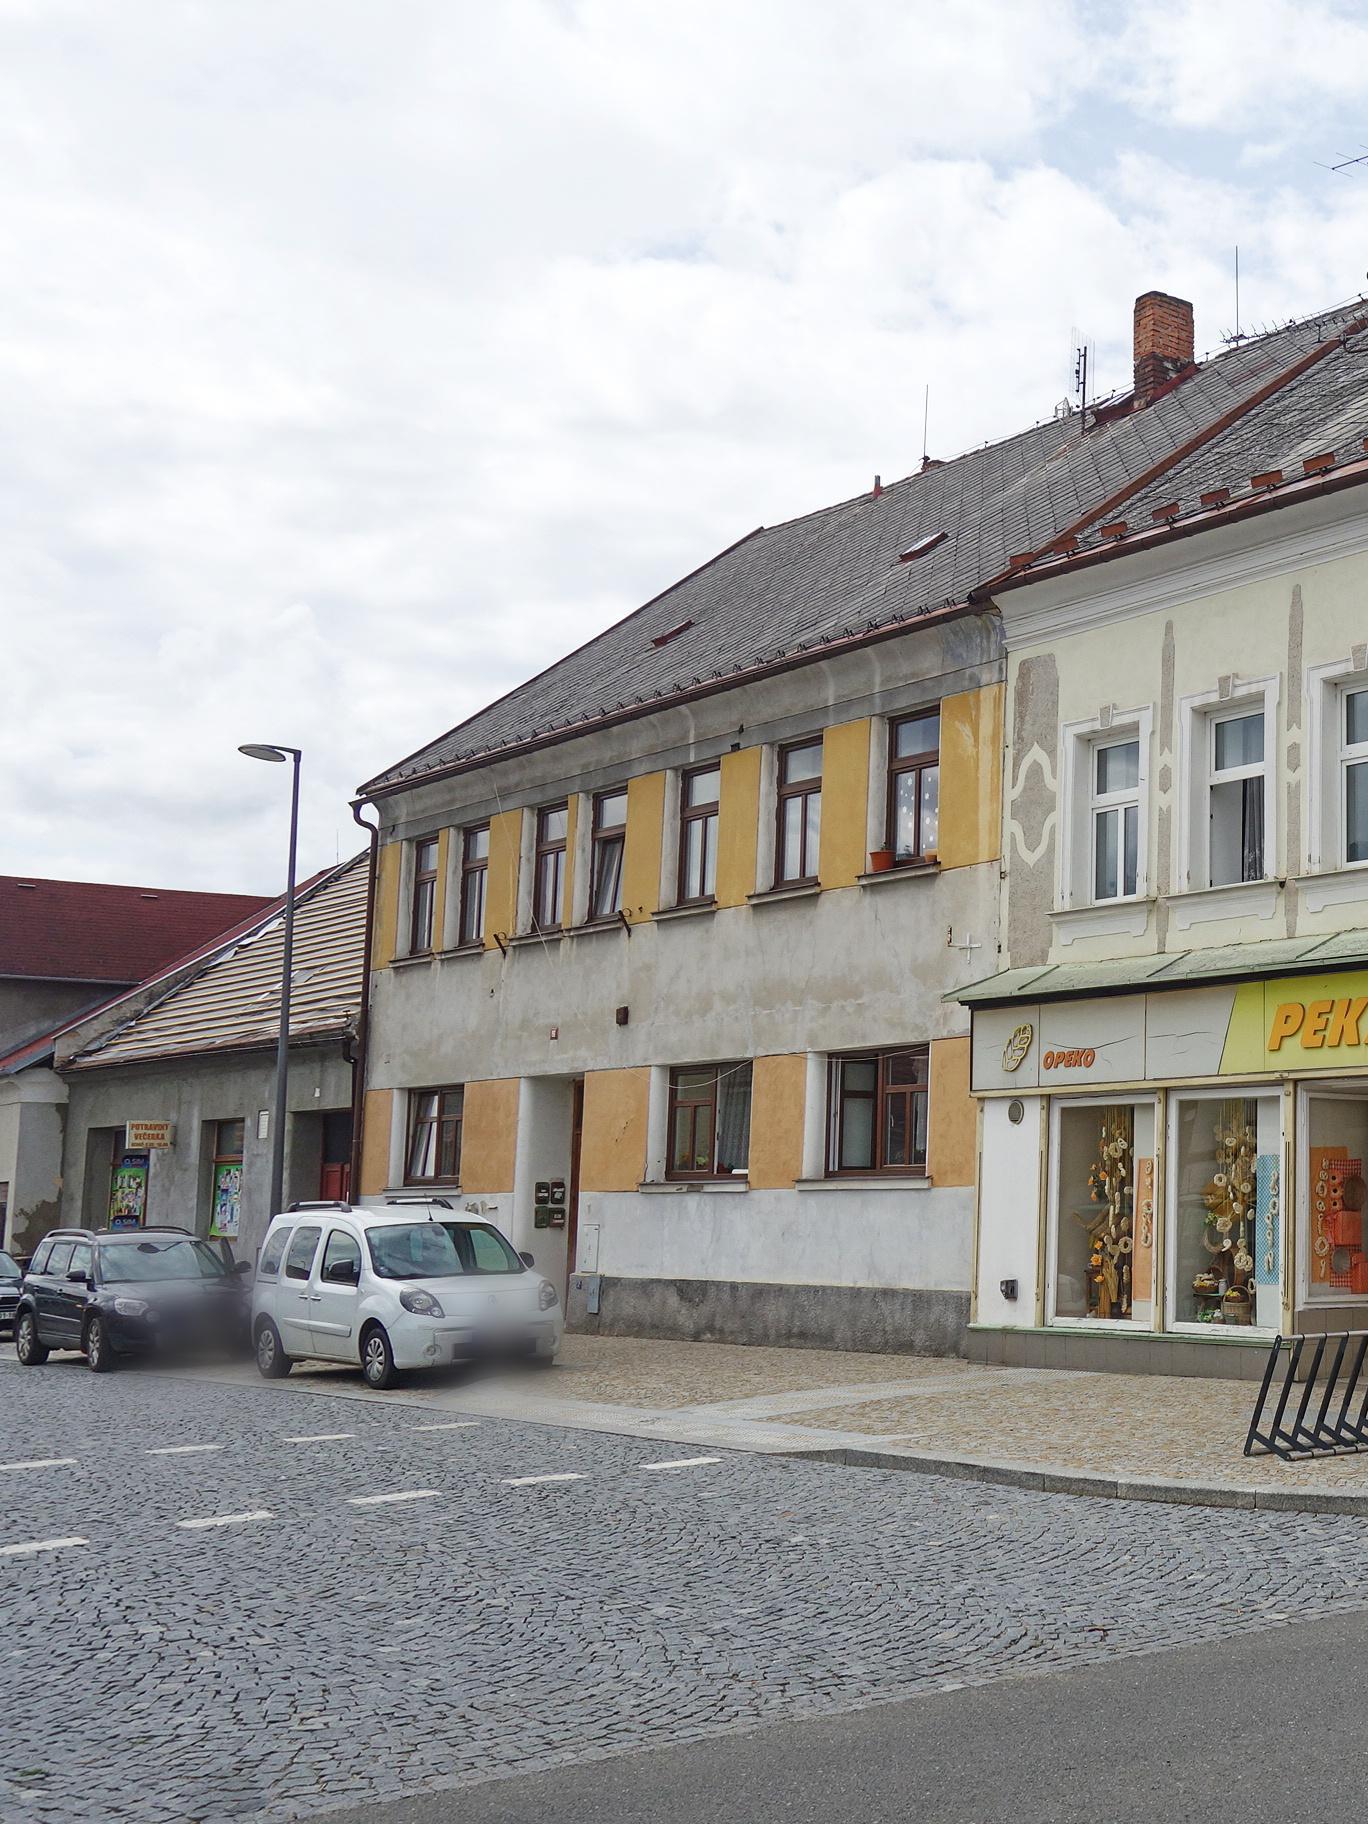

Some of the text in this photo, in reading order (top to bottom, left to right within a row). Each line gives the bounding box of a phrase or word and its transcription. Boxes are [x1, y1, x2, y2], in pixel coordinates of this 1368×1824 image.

[1043, 1047, 1095, 1070] OPEKO
[131, 1123, 168, 1131] POTRAVINY
[134, 1132, 165, 1140] VEČERKA
